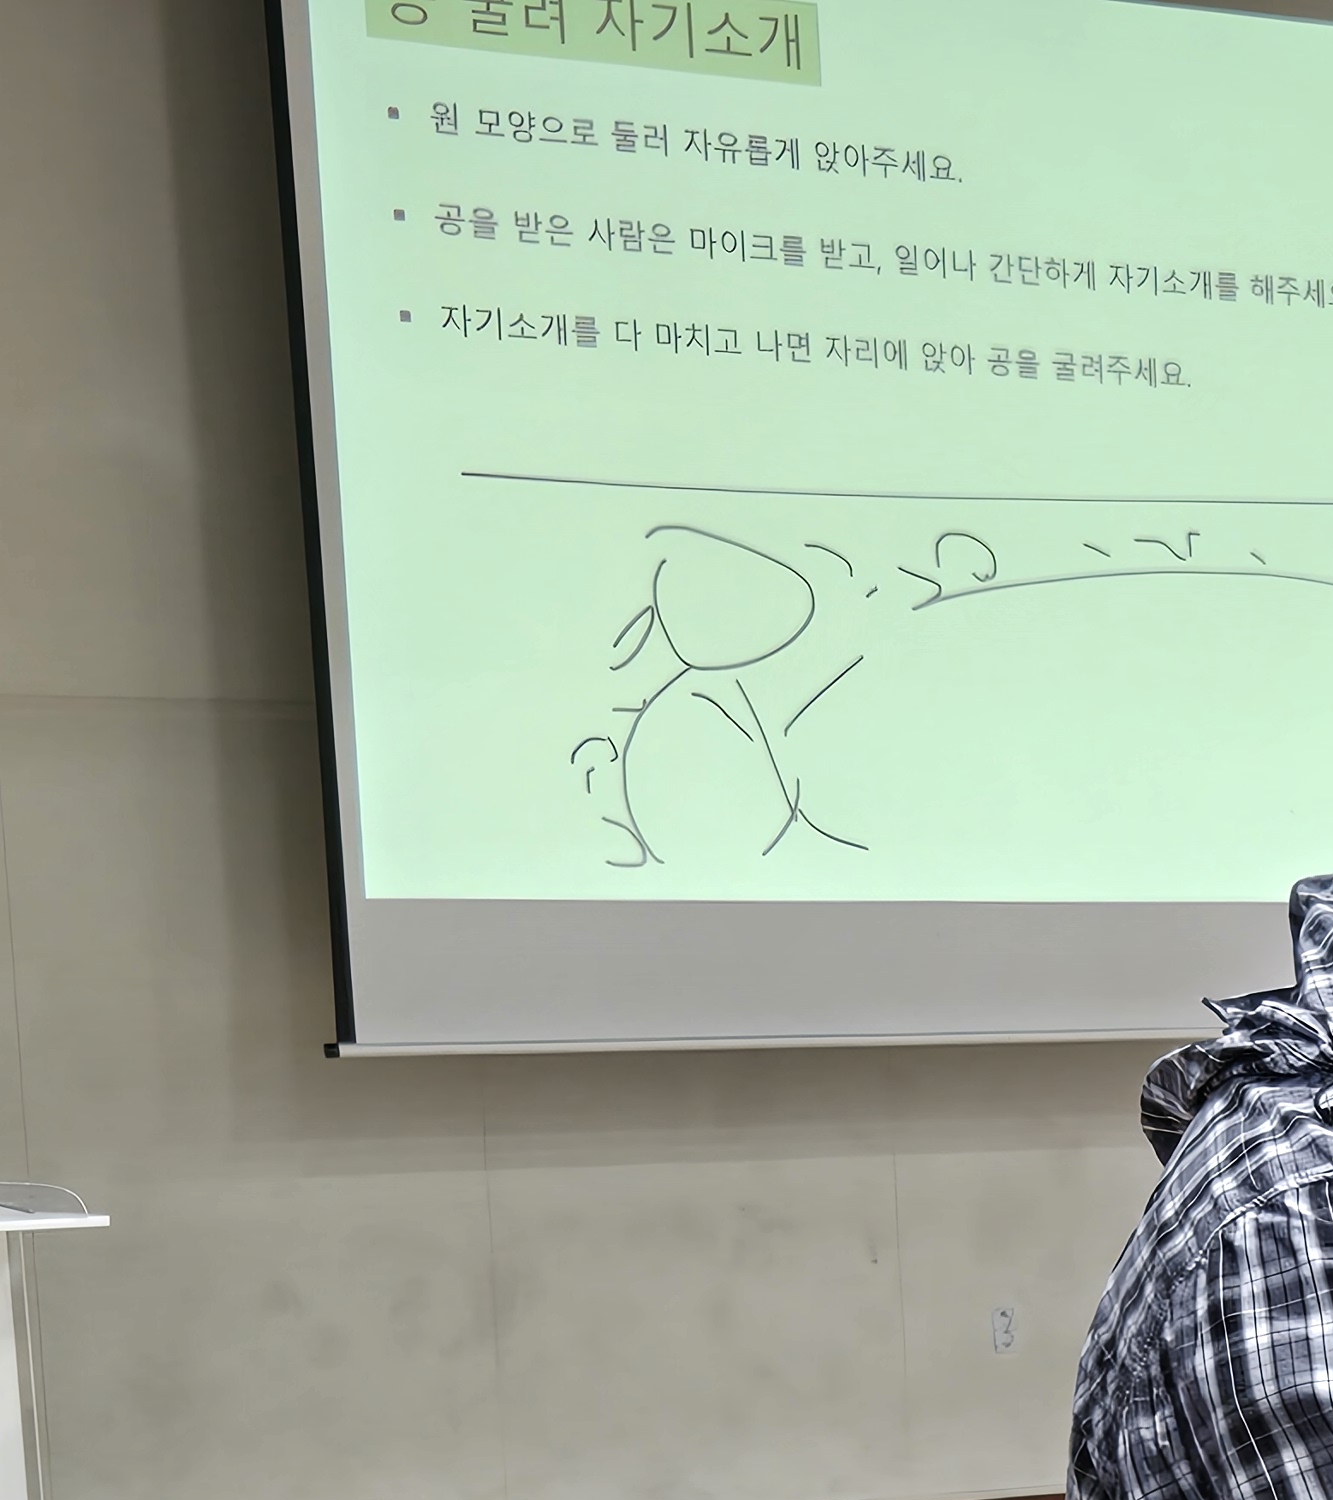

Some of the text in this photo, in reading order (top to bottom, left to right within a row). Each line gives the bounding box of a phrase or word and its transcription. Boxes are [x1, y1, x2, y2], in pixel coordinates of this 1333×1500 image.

[595, 0, 802, 71] 자기소개
[429, 101, 963, 184] 원 모양으로 둘러 자유롭게 앉아주세요.
[433, 203, 499, 241] 공을
[513, 210, 575, 248] 받은
[587, 217, 676, 256] 사람은
[689, 226, 808, 268] 마이크를
[819, 237, 882, 276] 받고,
[894, 244, 977, 282] 일어나
[989, 253, 1096, 292] 간단하게
[1108, 263, 1240, 303] 자기소개를
[440, 303, 1192, 389] 자기소개를 다 마치고 나면 자리에 앉아 공을 굴려주세요.
